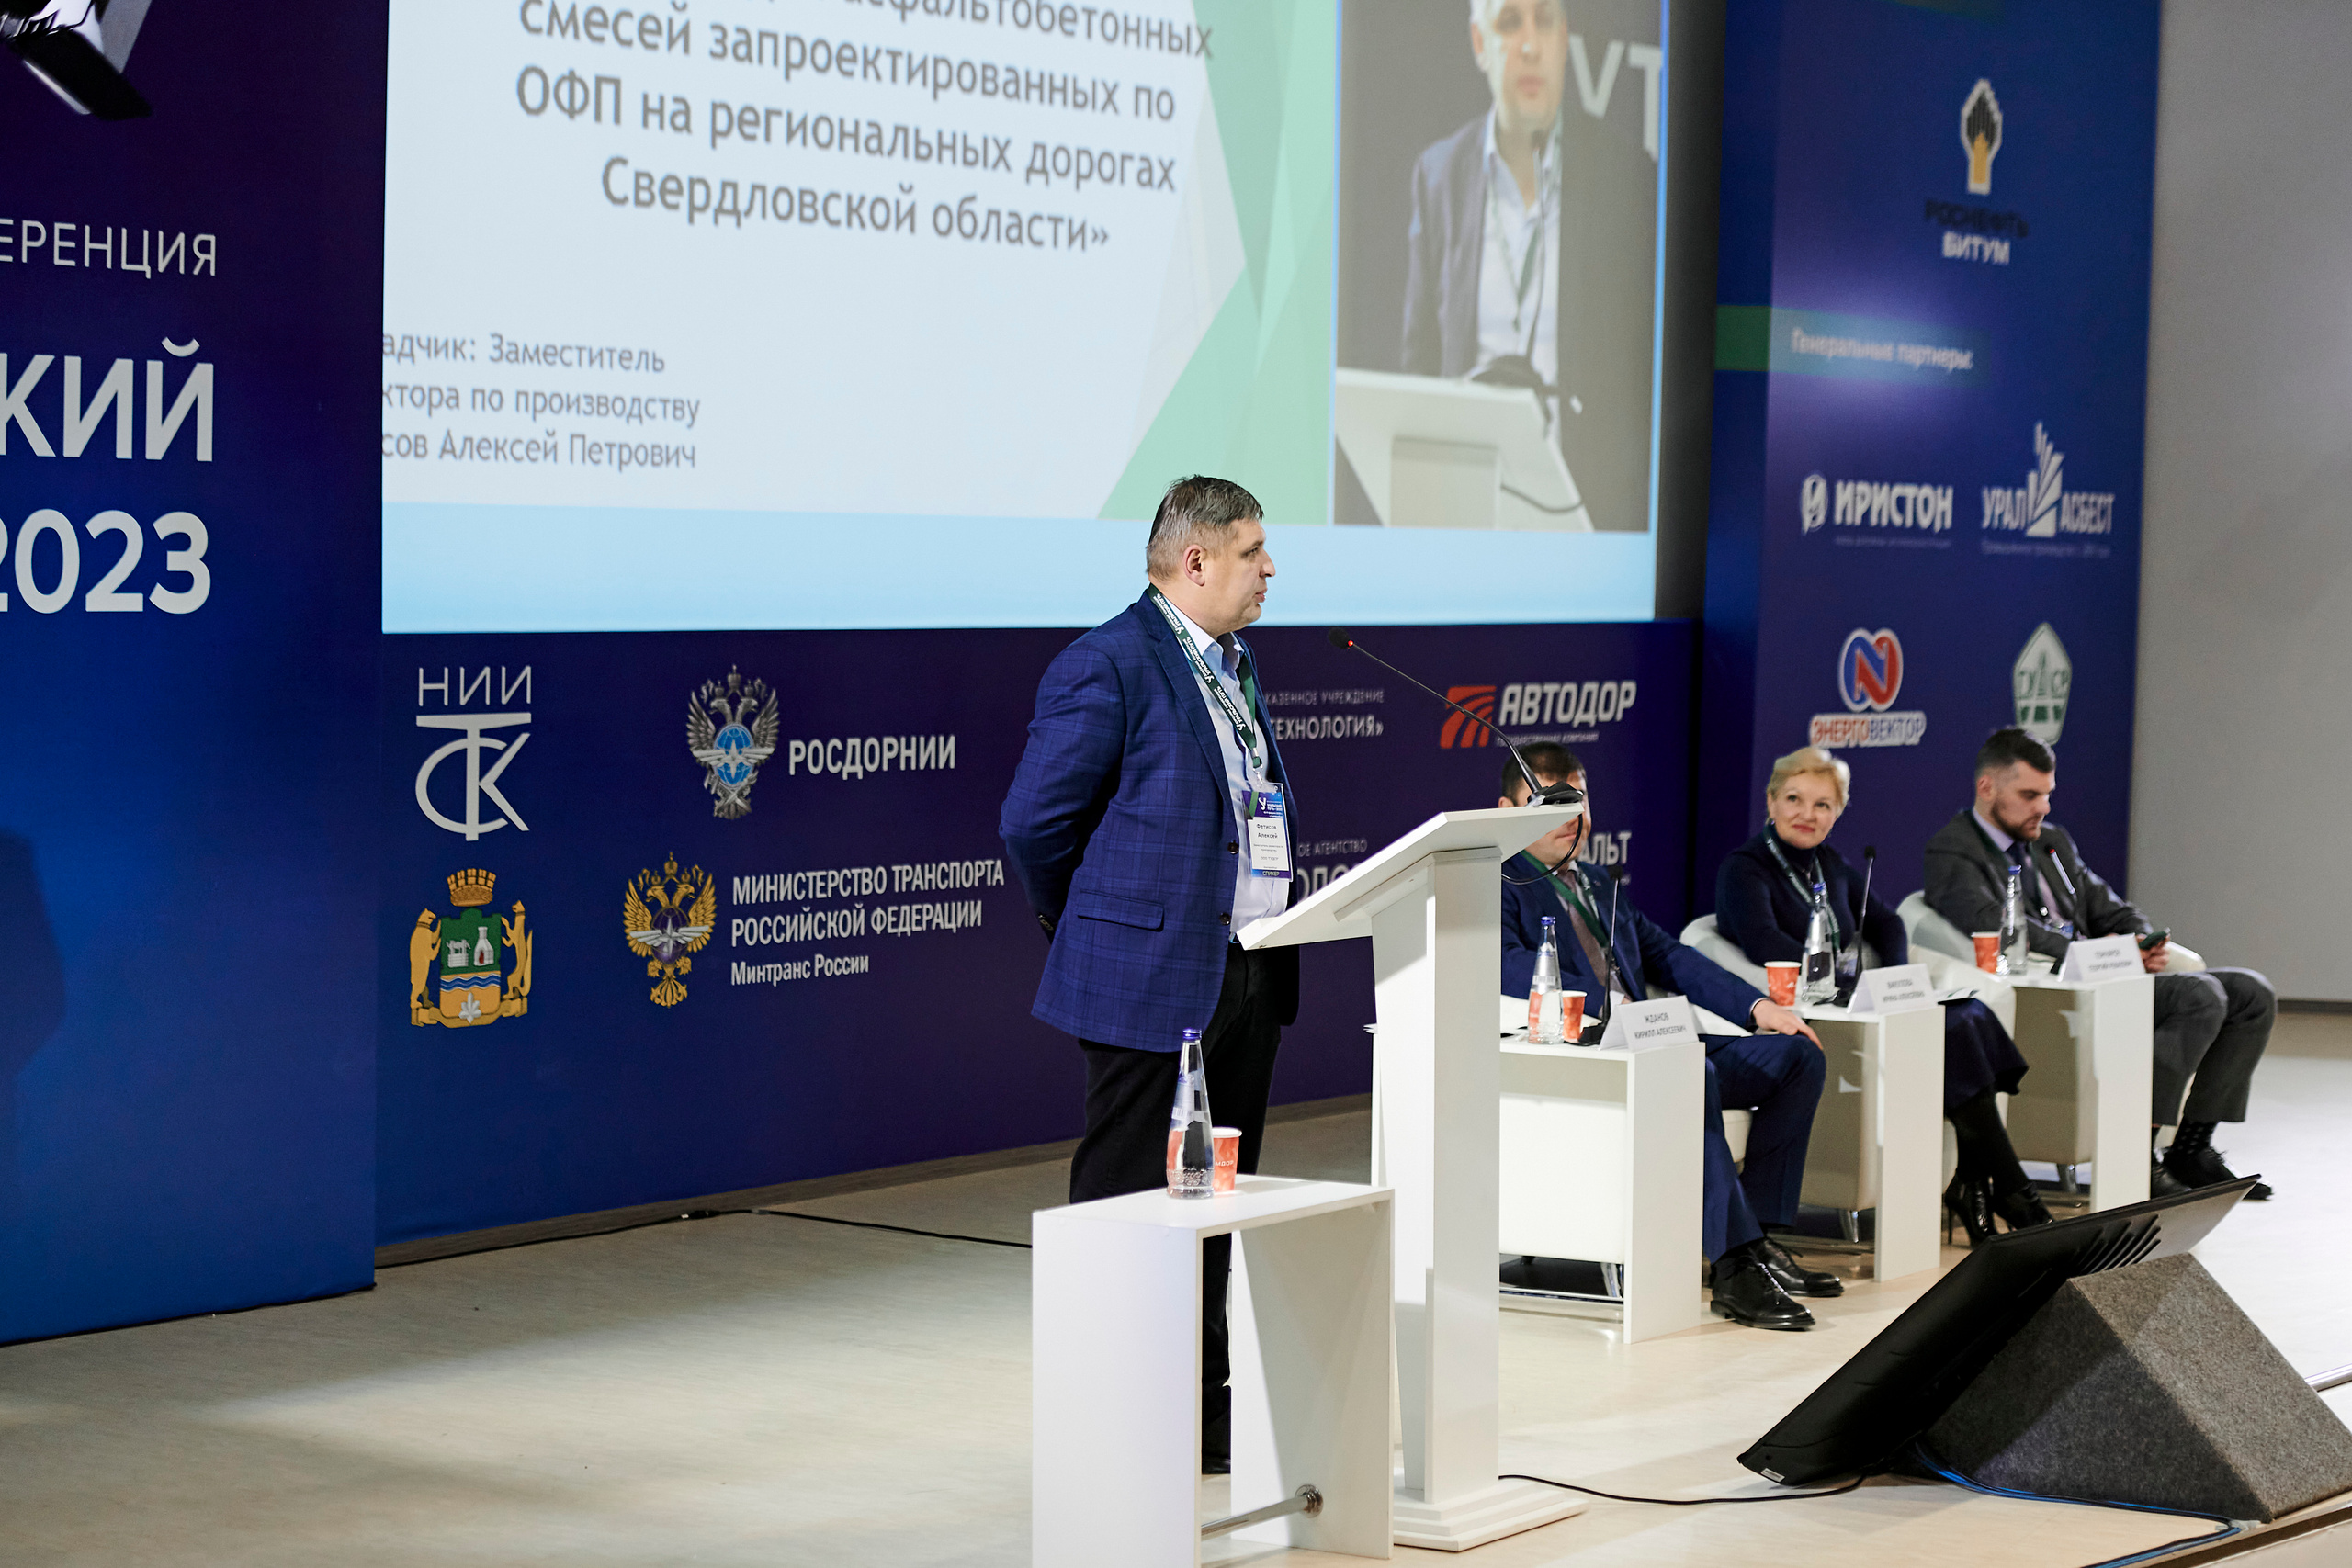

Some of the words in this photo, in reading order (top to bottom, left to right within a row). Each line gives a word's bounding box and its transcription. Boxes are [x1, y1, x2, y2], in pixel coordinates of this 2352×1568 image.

[846, 0, 1214, 59] фальтобетонных
[519, 0, 691, 55] смесей
[709, 22, 1120, 116] запроектированных
[1133, 85, 1176, 121] по
[516, 64, 623, 126] ОФП
[641, 91, 693, 135] на
[710, 99, 1012, 173] региональных
[1025, 141, 1176, 192] дорогах
[602, 155, 917, 234] Свердловской
[933, 195, 1109, 252] области»
[1942, 231, 2010, 265] БИТУМ
[382, 333, 477, 365] адчик:
[488, 332, 666, 373] Заместитель
[0, 336, 214, 462] КИЙ
[471, 387, 503, 412] по
[514, 389, 700, 429] производству
[438, 428, 559, 466] Алексей
[569, 433, 696, 473] Петрович
[1834, 479, 1953, 533] ИРИСТОН
[0, 508, 211, 615] 023
[418, 665, 532, 706] НИИ
[1320, 689, 1385, 705] УЧРЕЖДЕНИЕ
[1498, 680, 1637, 728] АВТОДОР
[1812, 716, 1926, 743] ЭНЕРГОВЕКТОР
[789, 734, 956, 781] РОСДОРНИИ
[1257, 831, 1279, 840] Алексей
[1313, 838, 1368, 856] АГЕНТСТВО
[732, 866, 888, 905] МИНИСТЕРСТВО
[891, 859, 1005, 893] ТРАНСПОРТА
[731, 902, 865, 947] РОССИЙСКОЙ
[870, 899, 982, 937] ФЕДЕРАЦИИ
[730, 960, 811, 987] Минтранс
[814, 953, 869, 978] России
